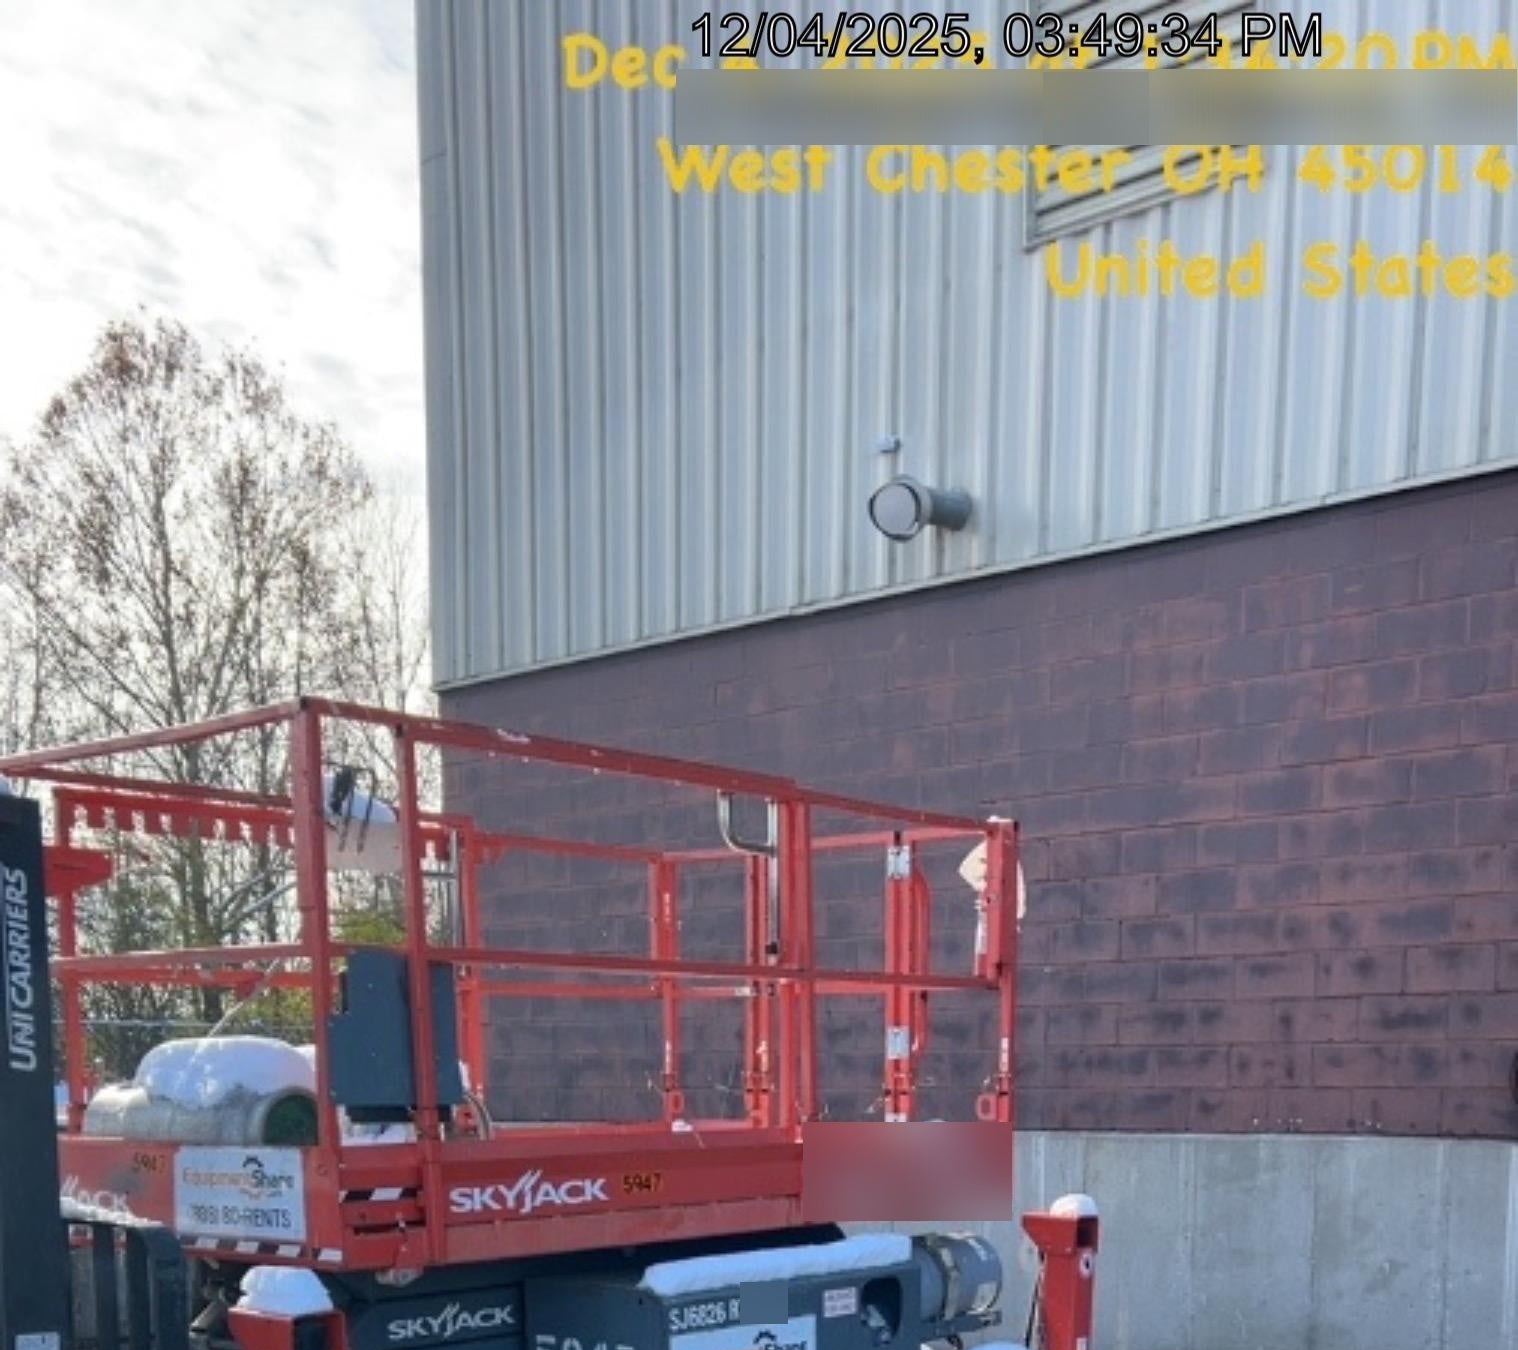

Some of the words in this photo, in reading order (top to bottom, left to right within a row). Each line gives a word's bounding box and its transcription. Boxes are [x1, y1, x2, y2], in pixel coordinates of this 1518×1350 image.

[450, 1169, 610, 1213] SKYJACK
[623, 1174, 662, 1194] 5947
[388, 1302, 515, 1339] SKYJACK
[668, 1302, 727, 1331] SJ6826
